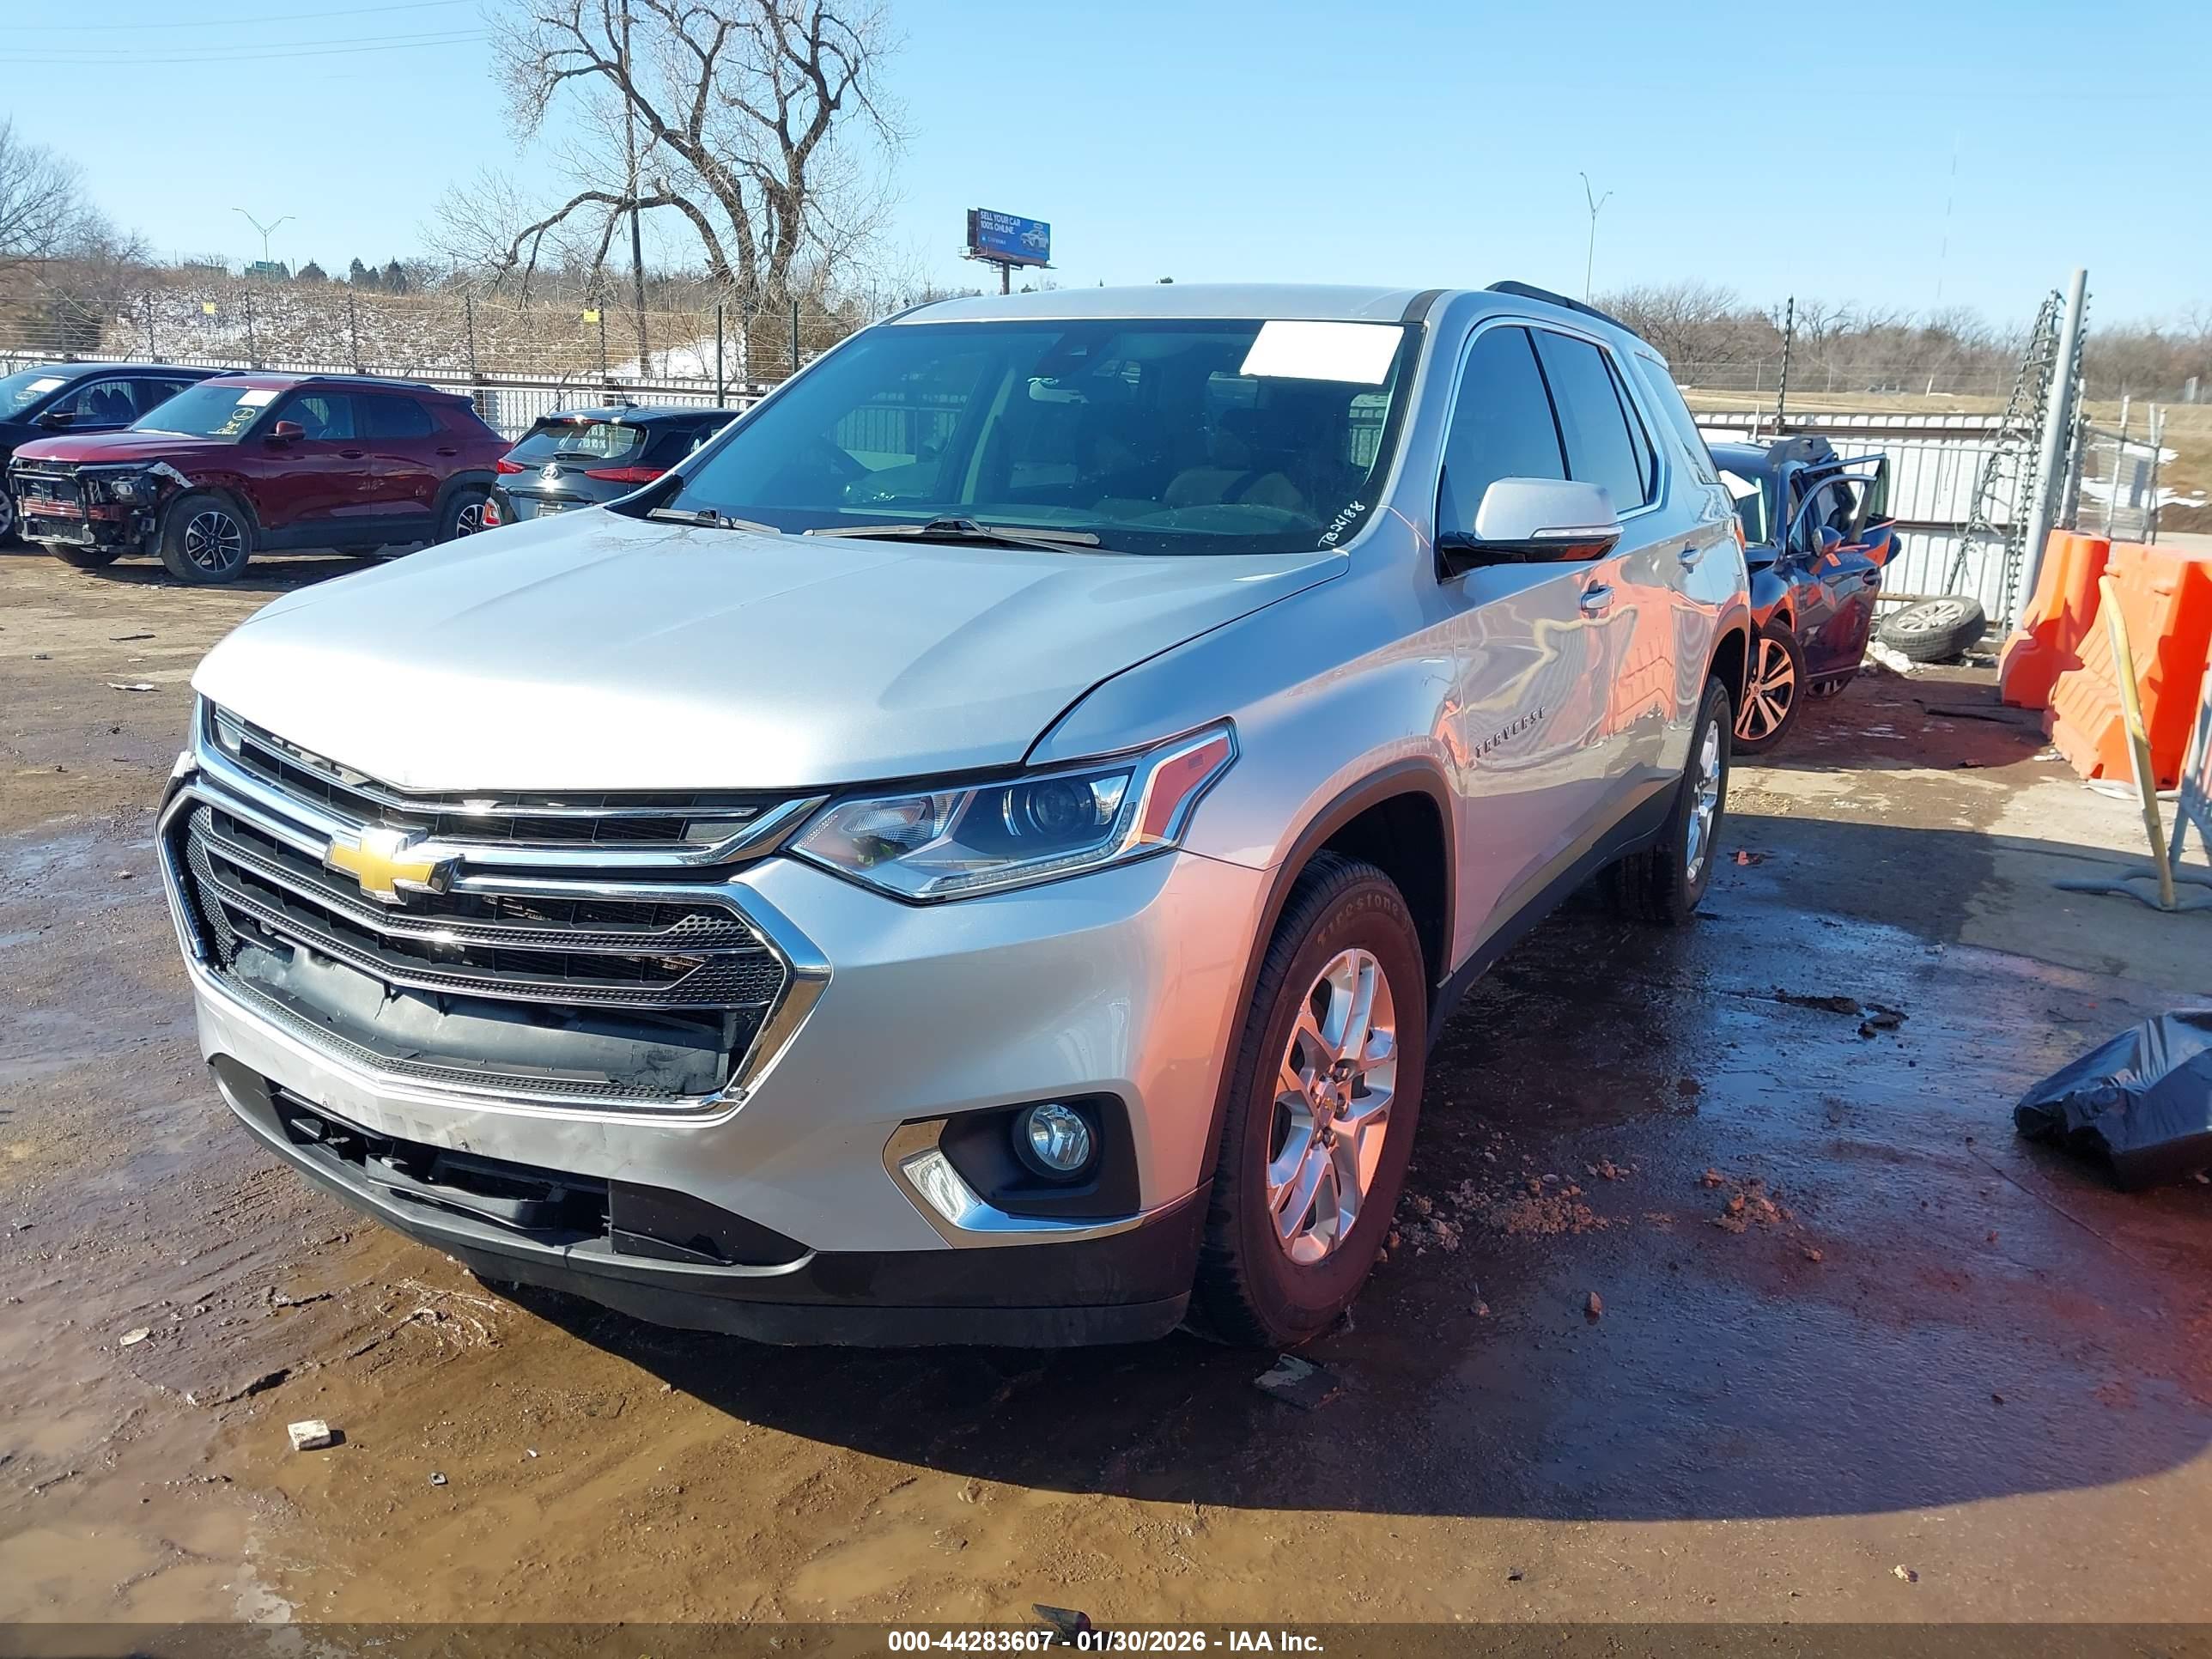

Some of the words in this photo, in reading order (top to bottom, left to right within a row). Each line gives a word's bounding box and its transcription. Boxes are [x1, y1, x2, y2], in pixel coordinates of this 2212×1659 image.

[981, 210, 993, 221] SELL
[994, 213, 1009, 225] YOUR
[1010, 216, 1021, 227] CAR
[981, 221, 994, 230] 100%
[1475, 706, 1546, 758] TRAVERSE
